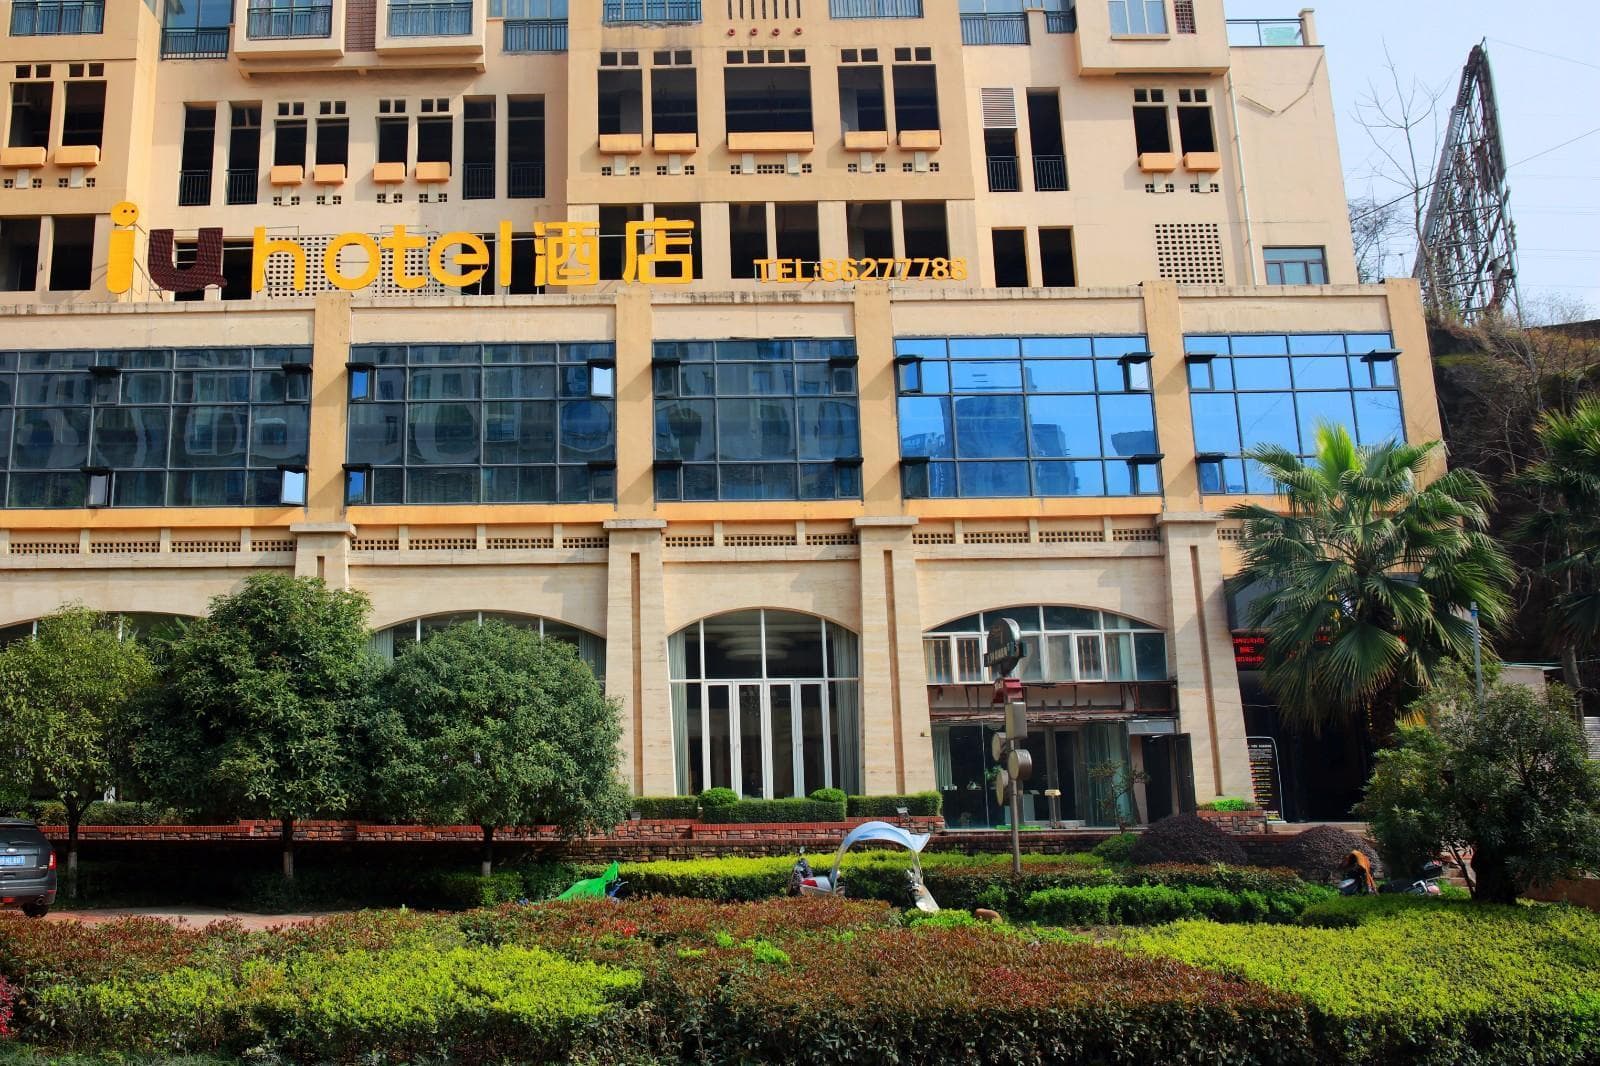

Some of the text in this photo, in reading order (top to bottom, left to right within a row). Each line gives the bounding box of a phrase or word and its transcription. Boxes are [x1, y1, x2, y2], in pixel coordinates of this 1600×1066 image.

[253, 220, 512, 292] hotel
[534, 217, 694, 286] 酒店
[753, 256, 968, 283] TEL:86277788
